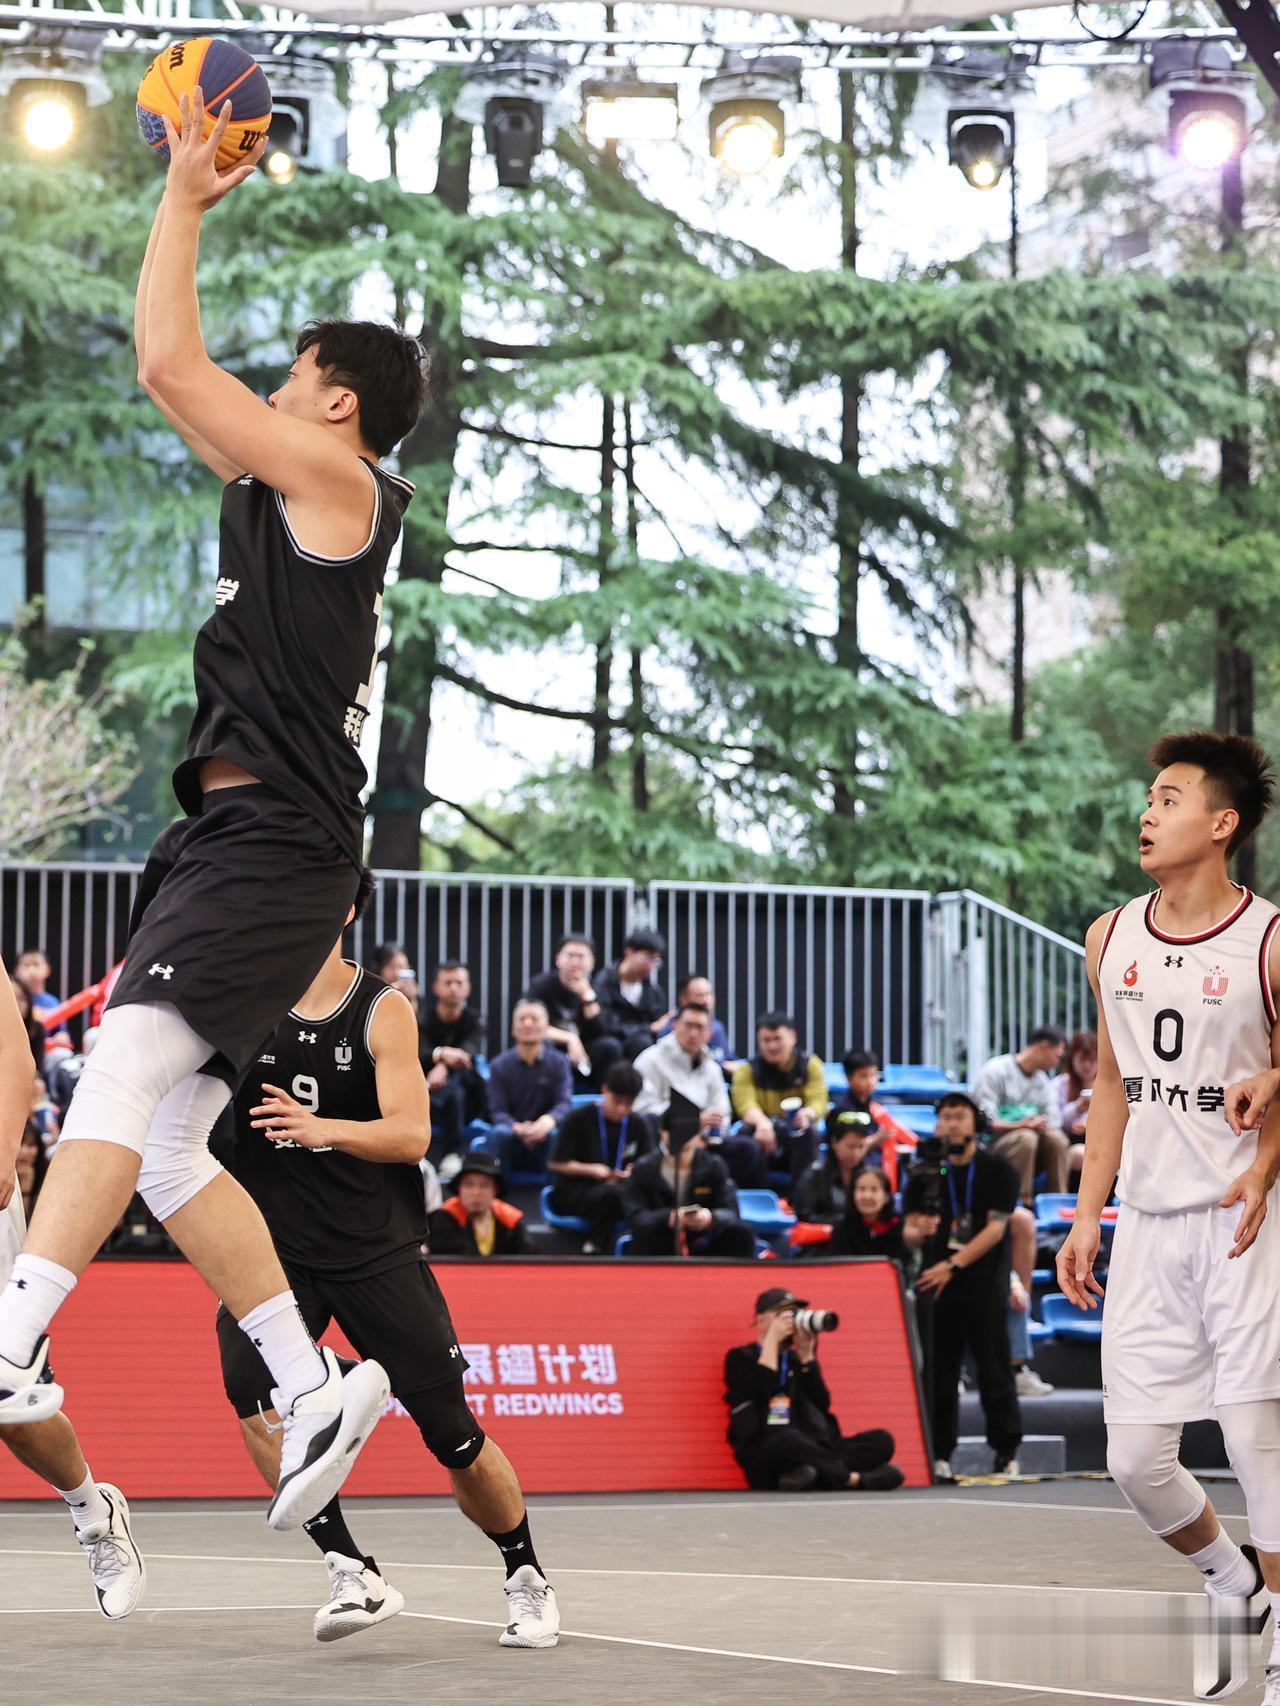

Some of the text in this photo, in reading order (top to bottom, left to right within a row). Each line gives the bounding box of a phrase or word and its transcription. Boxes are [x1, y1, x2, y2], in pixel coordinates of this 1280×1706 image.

[1153, 1008, 1184, 1062] 0
[292, 1074, 319, 1113] 9
[460, 1344, 617, 1384] 展翅计划
[493, 1392, 624, 1416] REDWINGS
